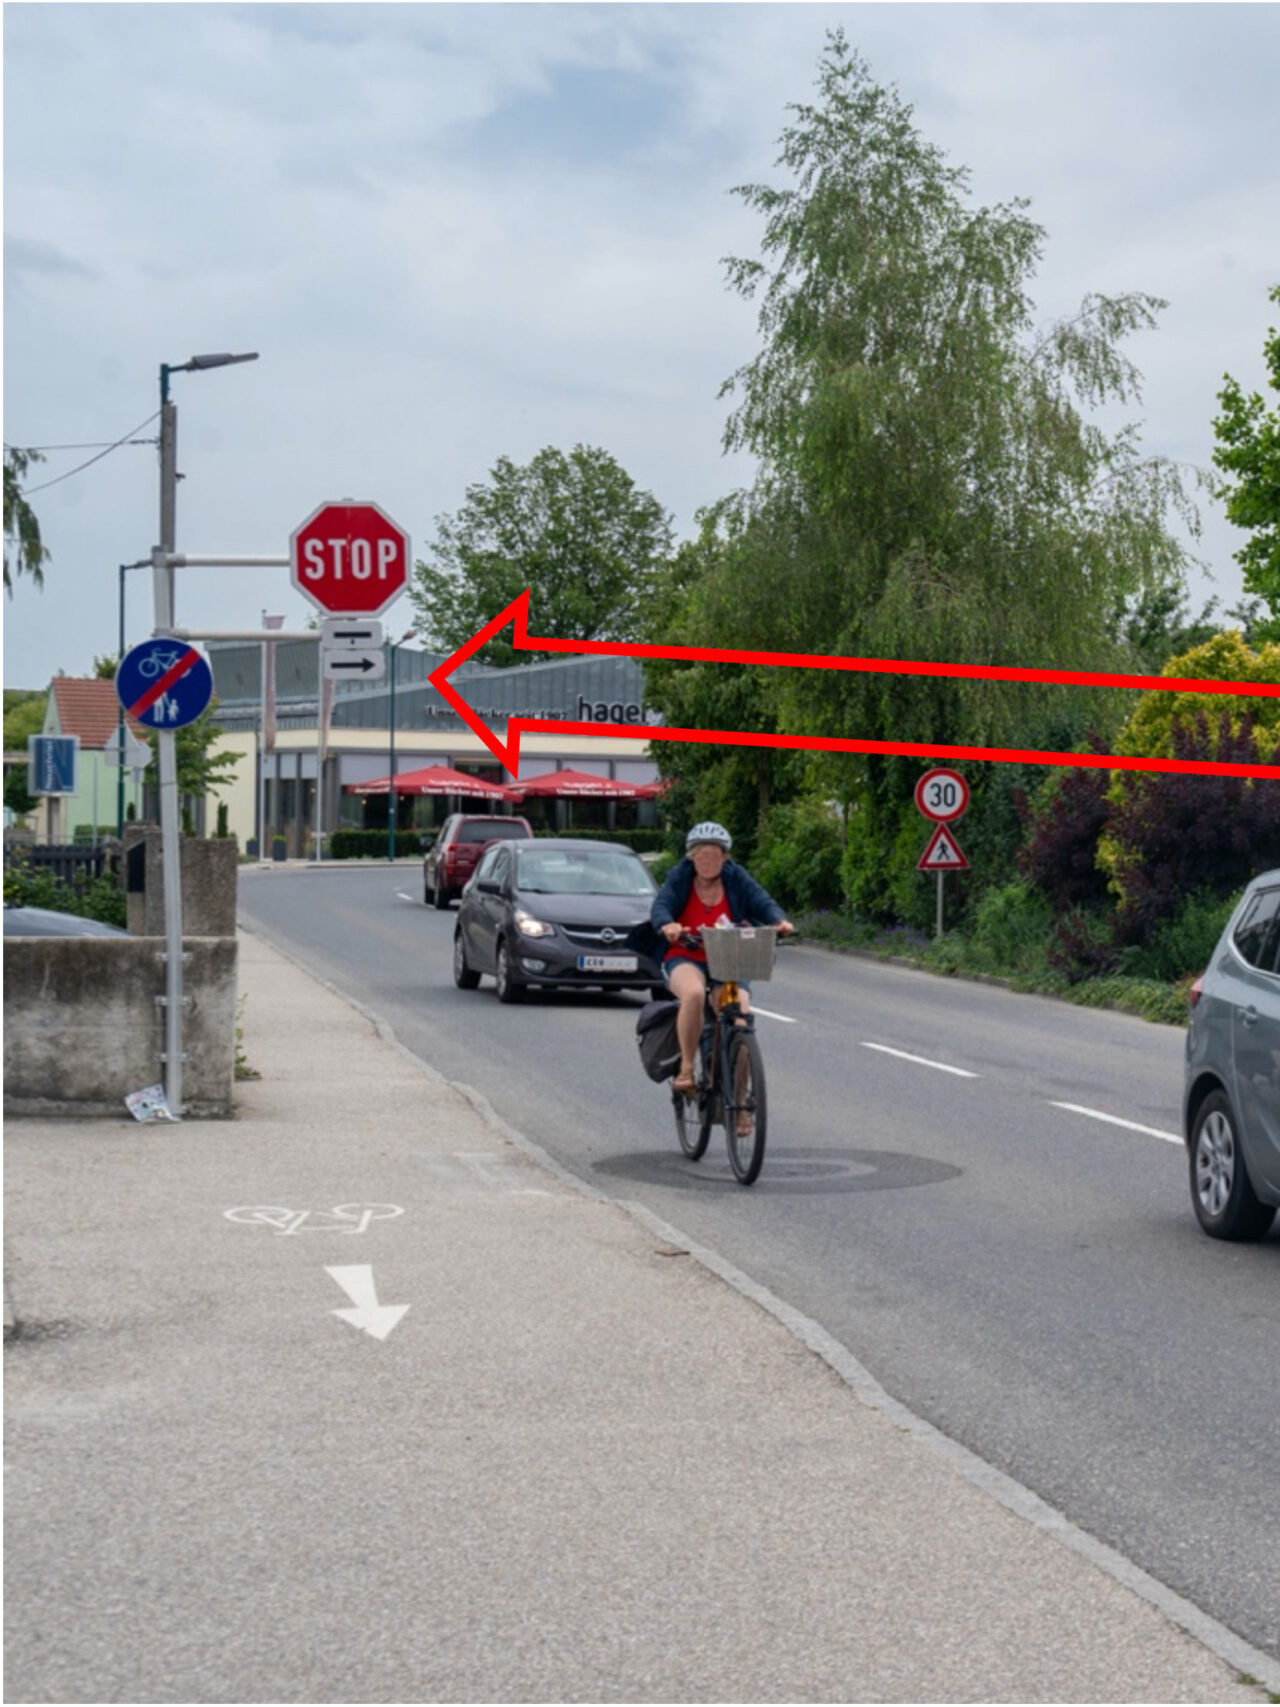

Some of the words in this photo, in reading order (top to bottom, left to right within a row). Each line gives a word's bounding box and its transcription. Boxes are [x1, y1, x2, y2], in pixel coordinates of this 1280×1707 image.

[304, 538, 397, 580] STOP
[428, 706, 456, 717] Unse
[930, 782, 956, 807] 30
